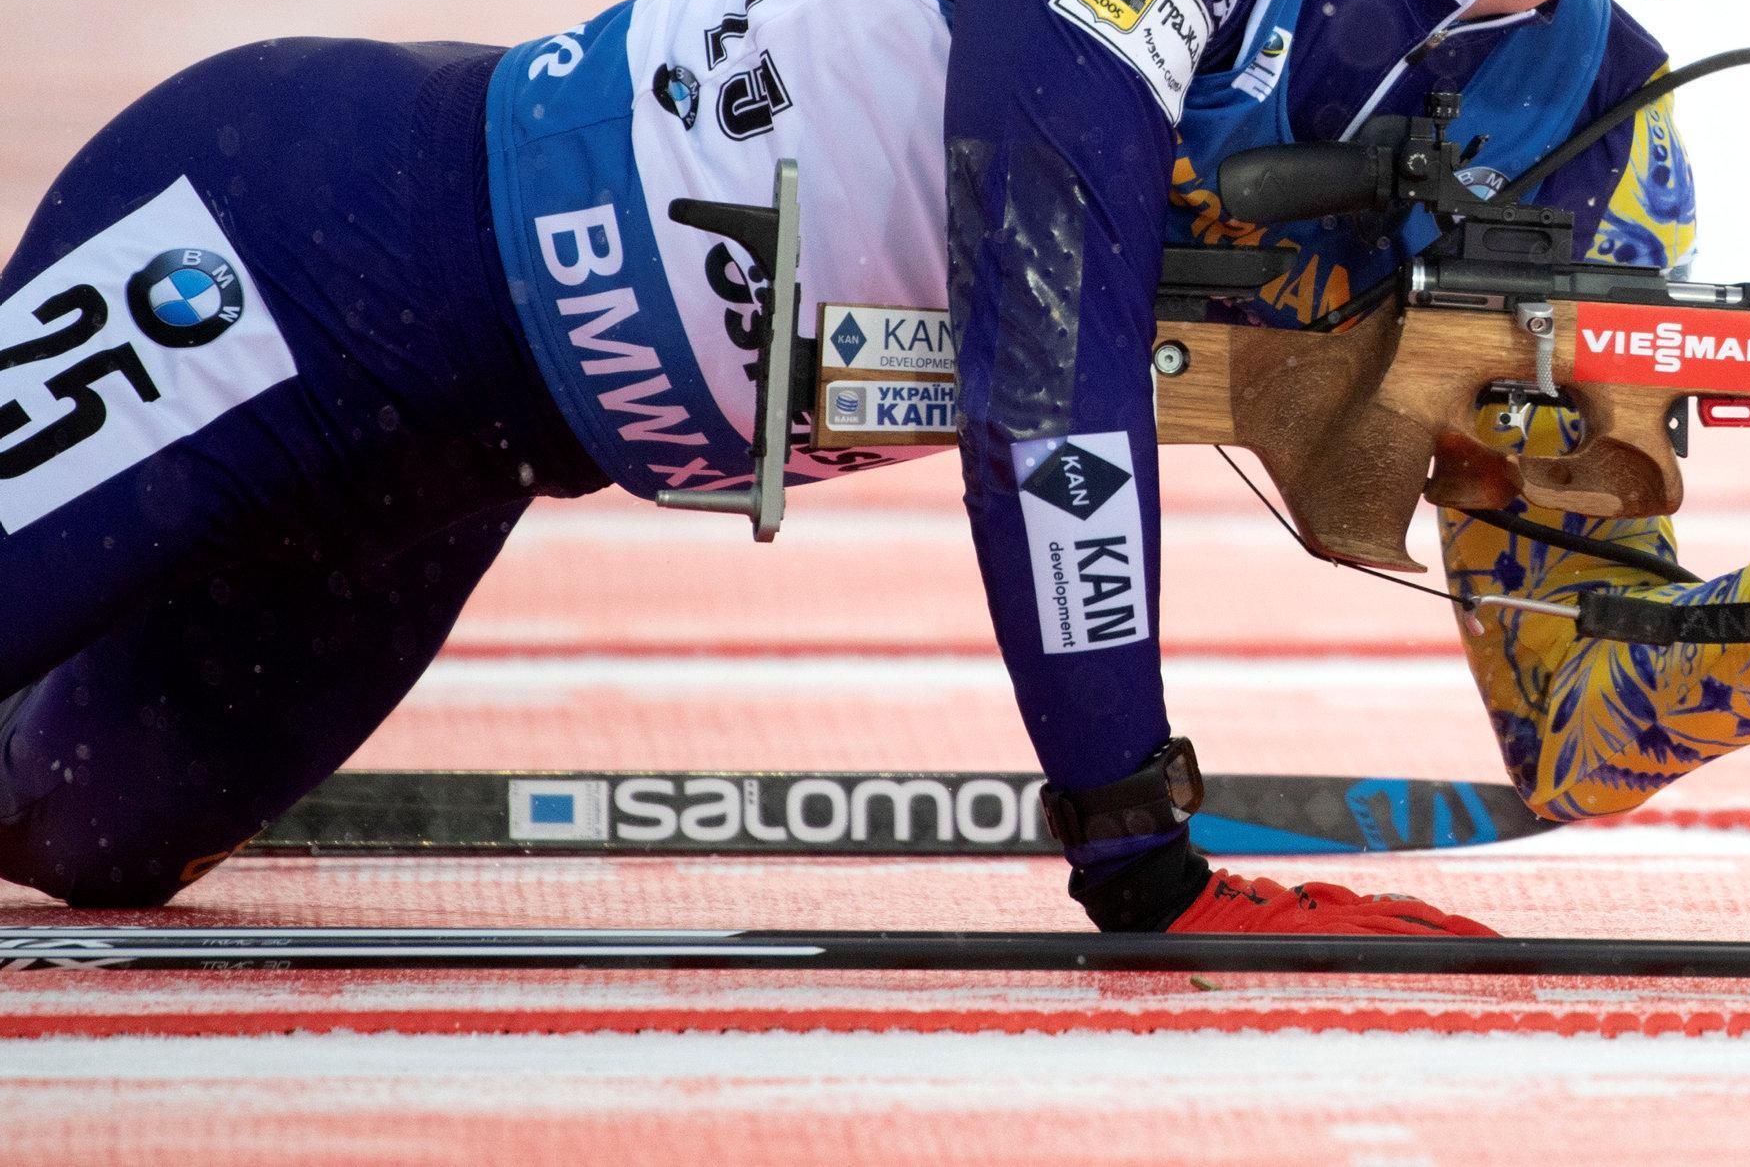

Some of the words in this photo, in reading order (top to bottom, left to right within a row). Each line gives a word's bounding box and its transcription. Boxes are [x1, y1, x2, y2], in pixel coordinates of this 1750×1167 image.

[1458, 171, 1504, 191] BM
[181, 249, 241, 323] BMW
[534, 203, 710, 446] BMW
[837, 334, 859, 345] KAN
[883, 318, 955, 353] KAN
[1060, 454, 1090, 507] KAN
[1048, 541, 1076, 648] development
[1073, 535, 1137, 644] KAN
